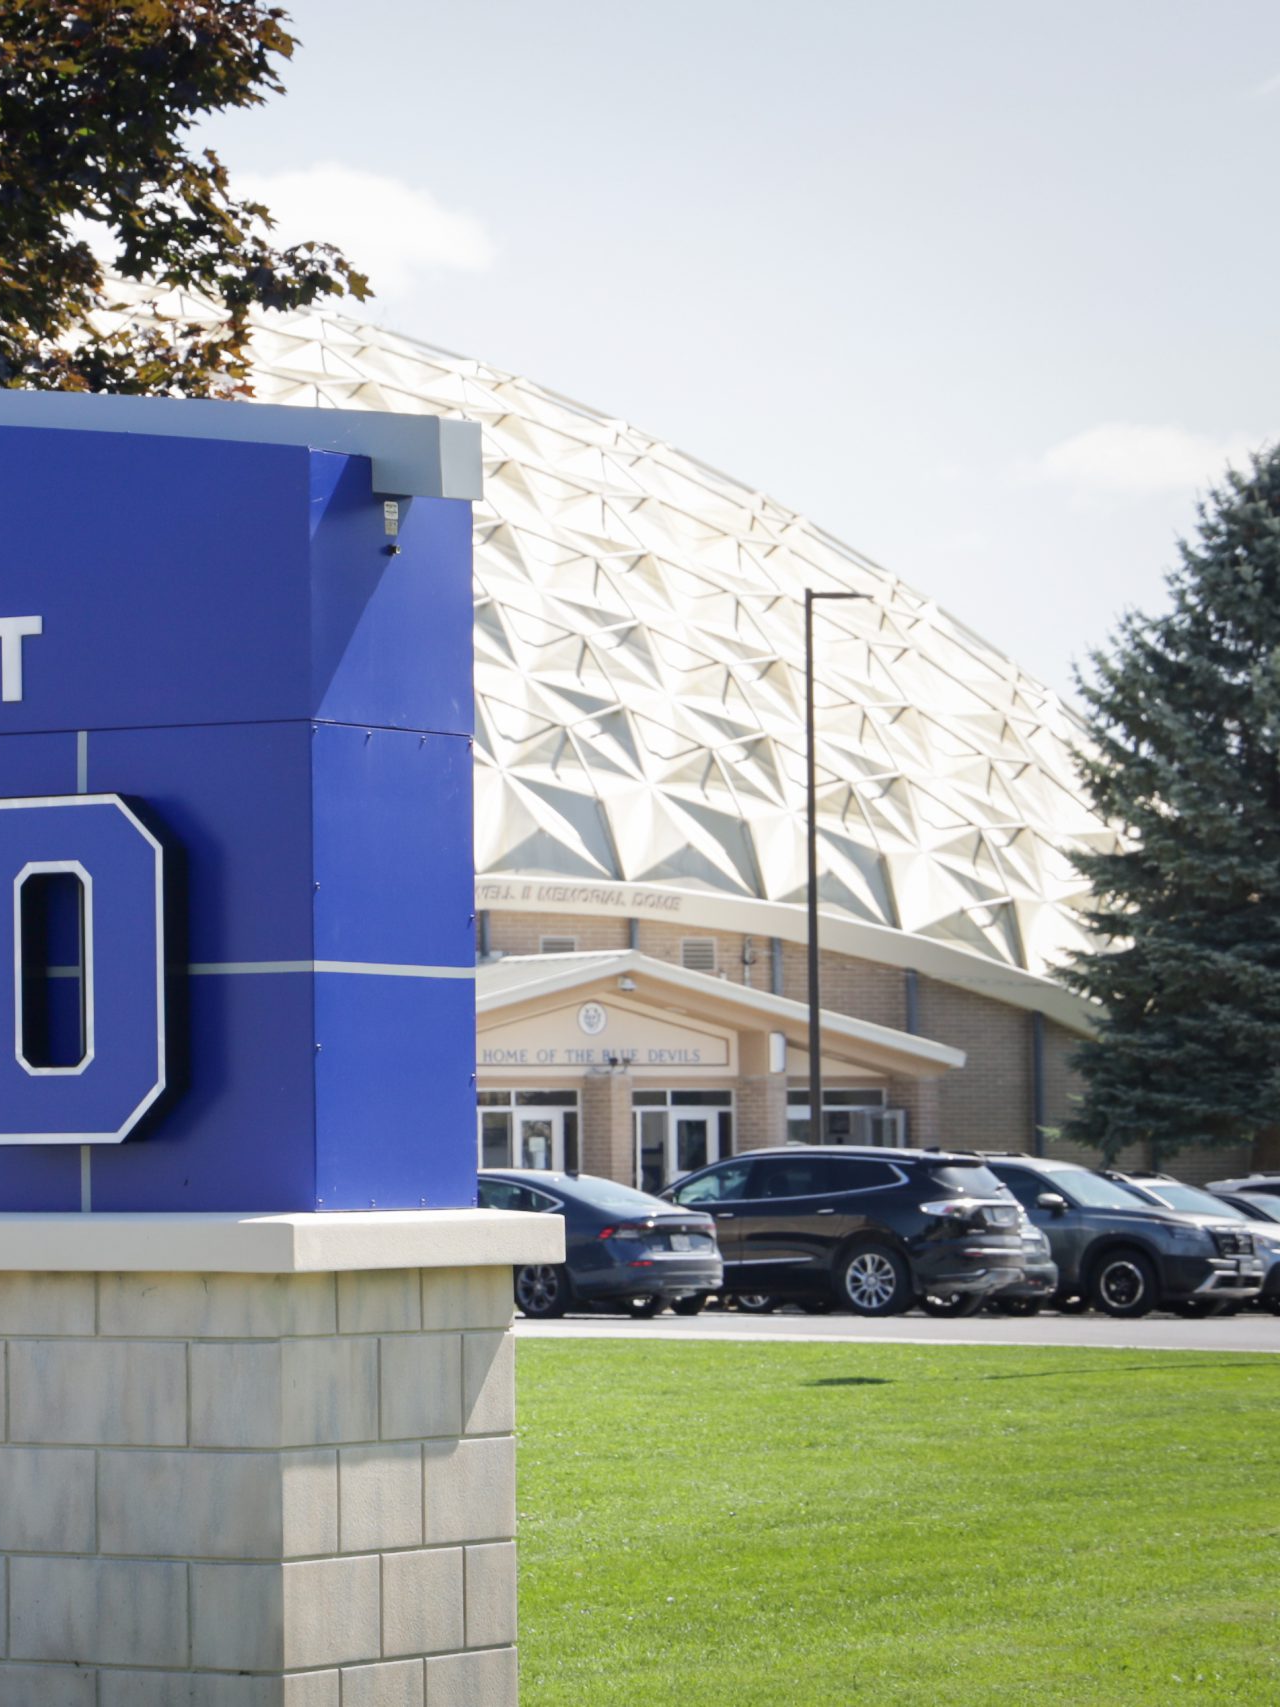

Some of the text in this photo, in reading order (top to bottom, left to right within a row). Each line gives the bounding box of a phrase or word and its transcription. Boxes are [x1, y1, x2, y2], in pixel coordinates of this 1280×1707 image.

[537, 886, 627, 908] MEMORIAL
[631, 891, 682, 912] DOME
[483, 1049, 527, 1063] HOME
[536, 1049, 556, 1063] OF
[565, 1049, 595, 1063] THE
[648, 1049, 701, 1062] DEVILS
